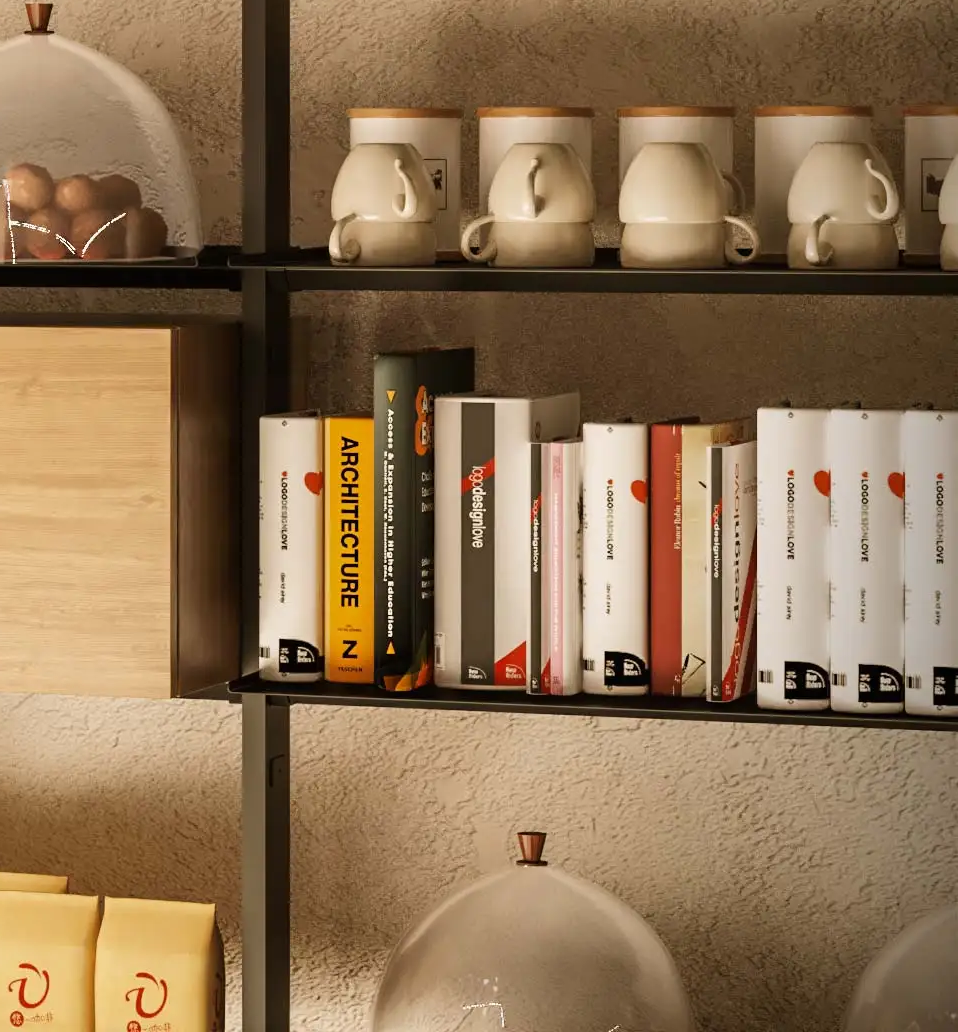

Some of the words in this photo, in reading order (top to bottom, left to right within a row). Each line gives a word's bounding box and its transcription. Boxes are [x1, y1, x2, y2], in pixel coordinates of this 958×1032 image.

[388, 453, 395, 461] &
[386, 465, 395, 522] Expansion
[469, 466, 487, 548] logodesignlove
[341, 437, 359, 607] ARCHITECTURE
[388, 526, 395, 537] in
[531, 499, 541, 572] logodesignlove
[386, 540, 395, 577] Higher
[342, 640, 358, 659] Z
